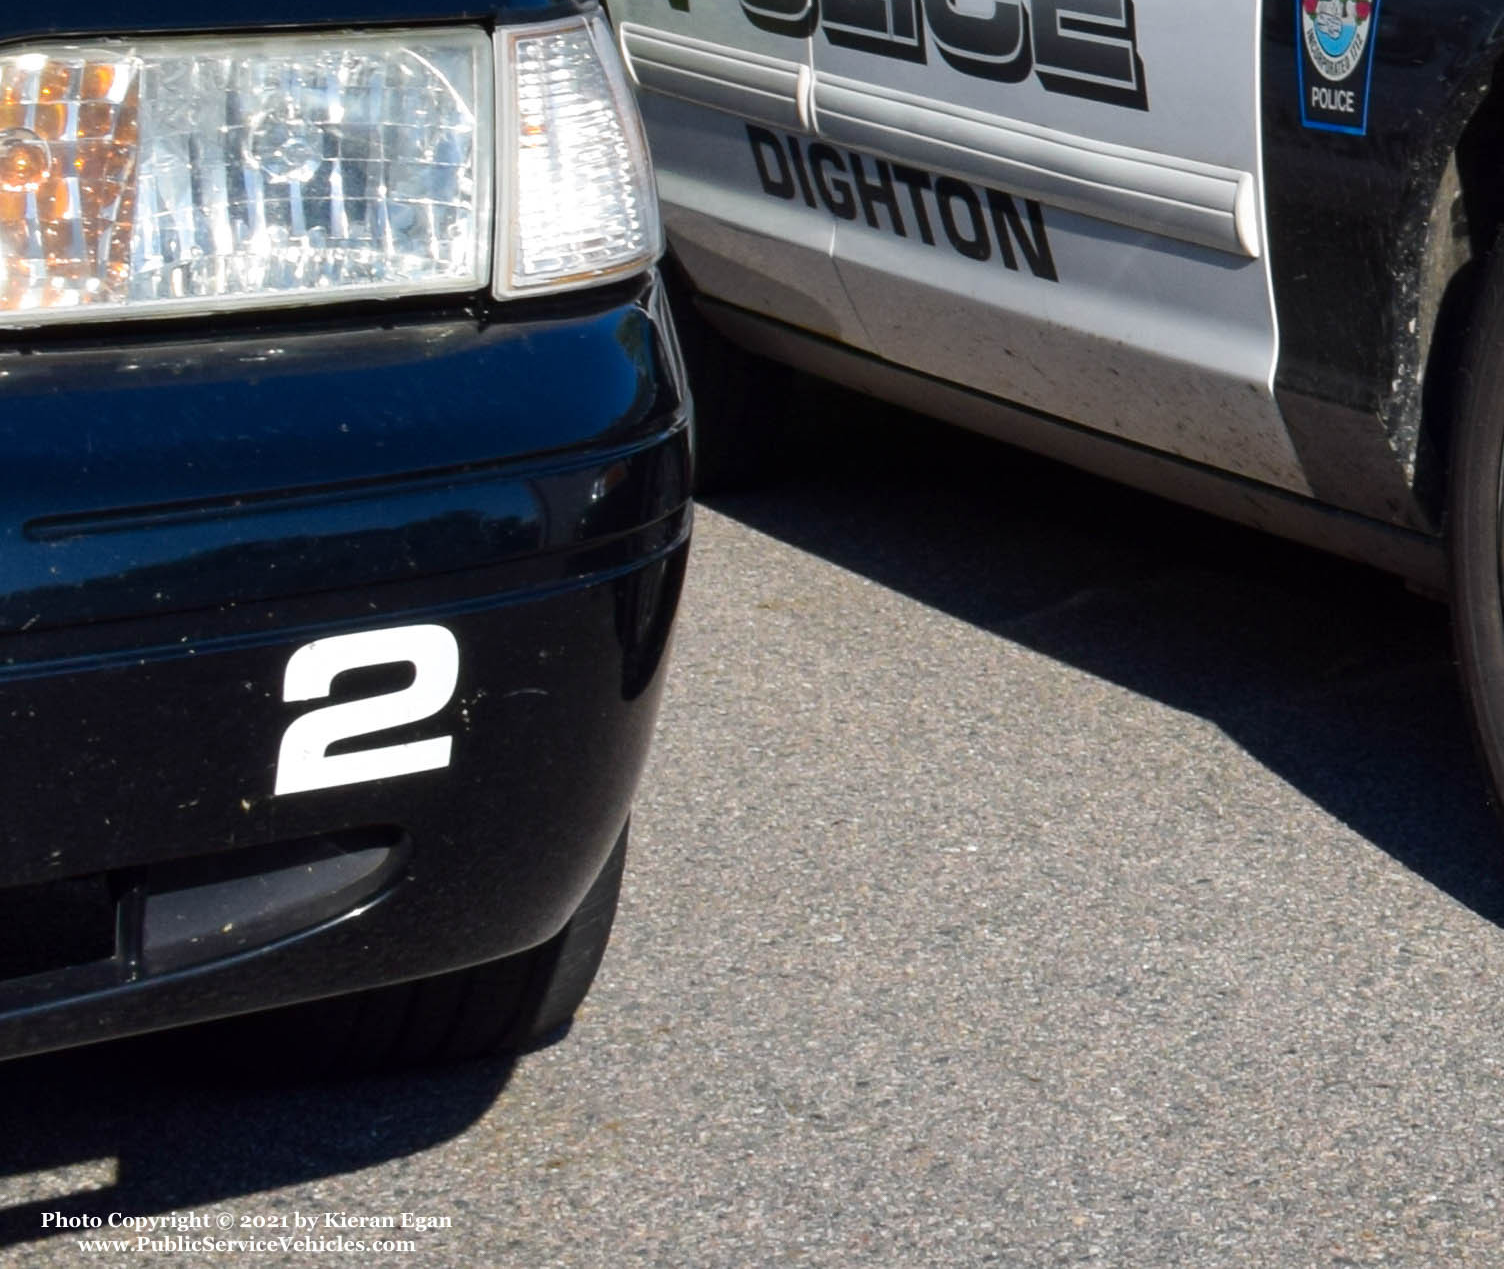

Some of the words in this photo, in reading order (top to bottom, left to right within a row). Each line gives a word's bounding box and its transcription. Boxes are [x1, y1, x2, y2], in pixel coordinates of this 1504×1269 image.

[1311, 86, 1355, 113] POLICE
[746, 124, 1059, 283] DIGHTON
[274, 624, 460, 795] 2
